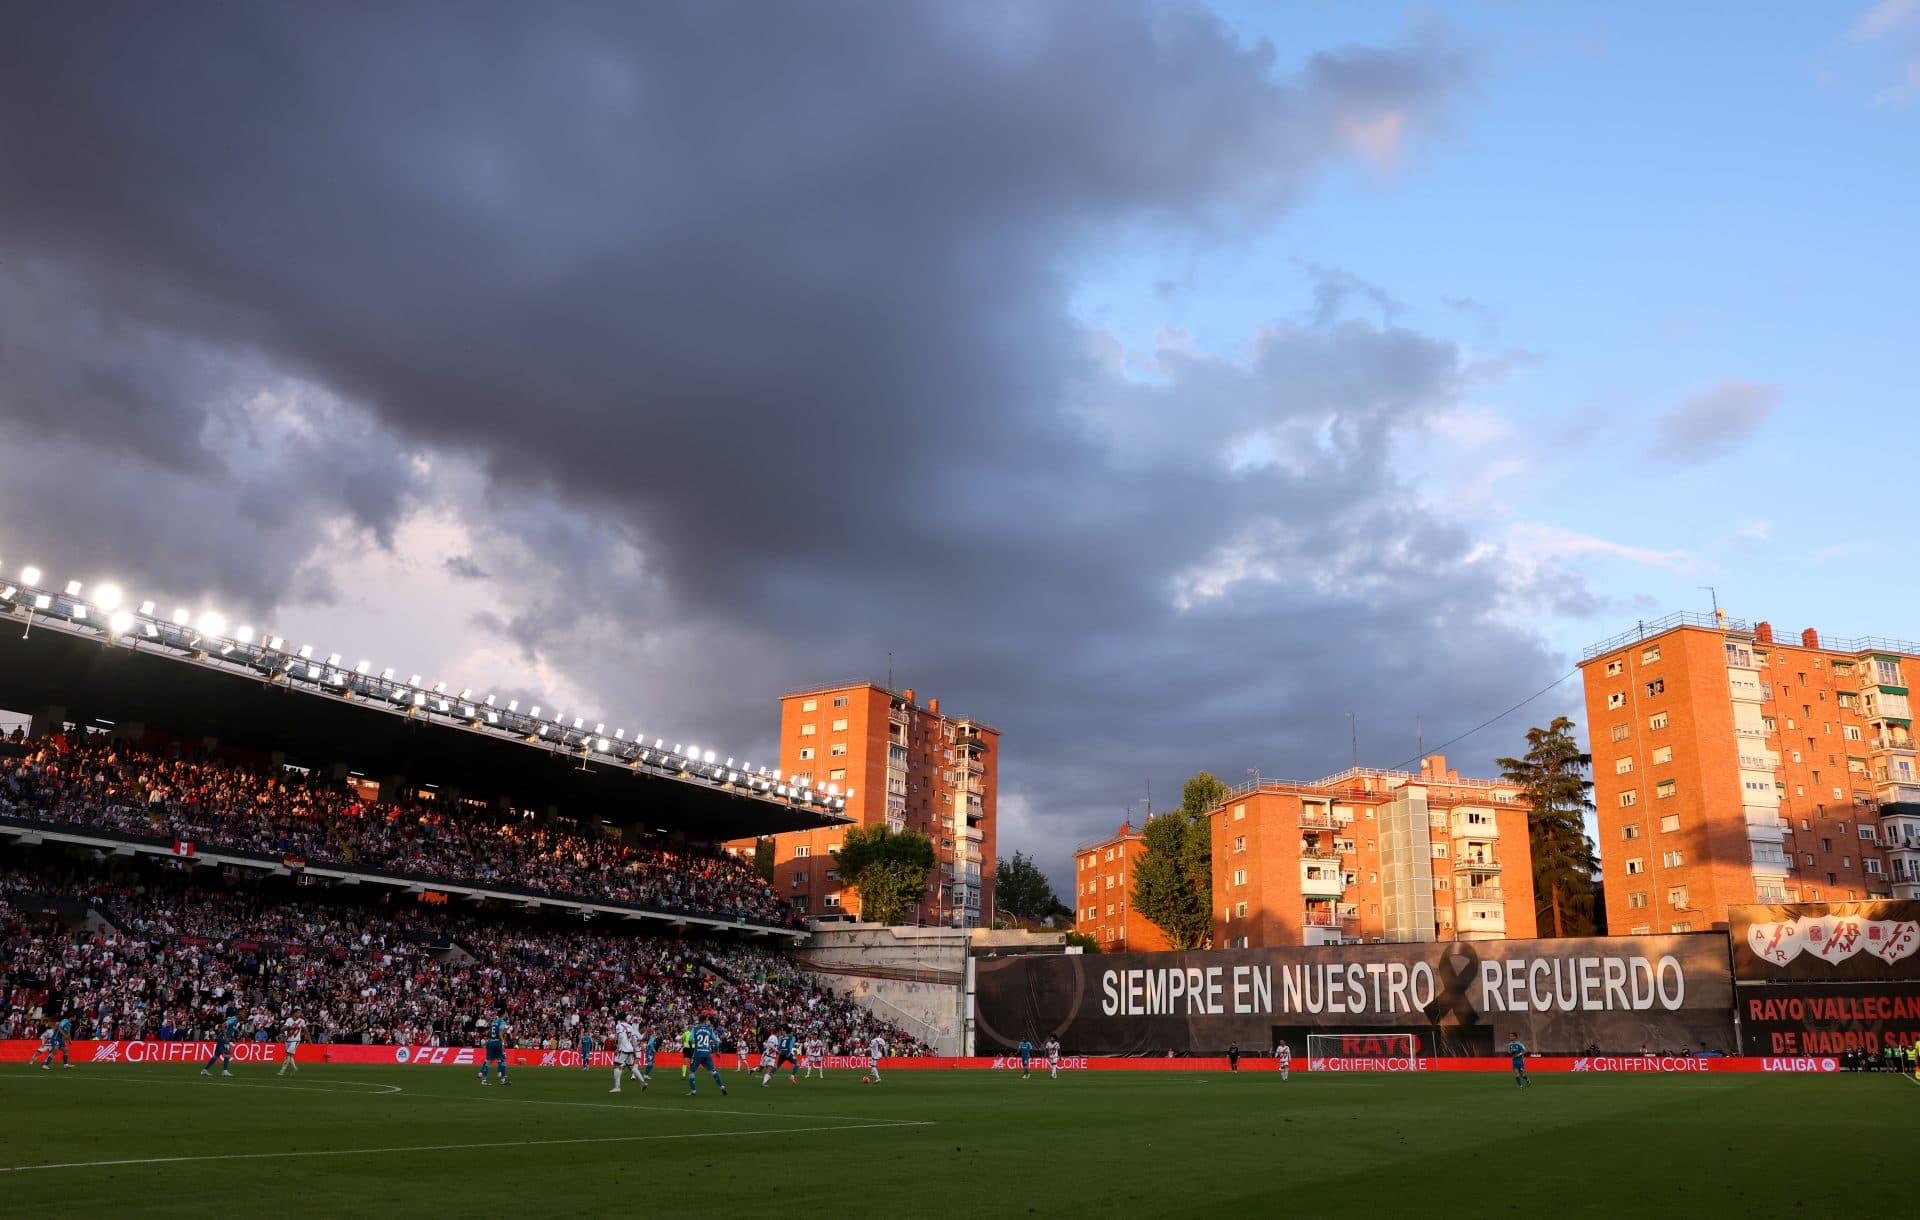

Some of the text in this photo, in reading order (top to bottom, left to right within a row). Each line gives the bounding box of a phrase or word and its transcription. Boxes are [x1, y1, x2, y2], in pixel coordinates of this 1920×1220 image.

[1755, 927, 1794, 939] A D
[1839, 943, 1852, 952] M
[1775, 950, 1787, 961] R
[1102, 955, 1685, 1016] SIEMPRE EN NUESTRO RECUERDO
[1750, 998, 1803, 1021] RAYO
[697, 1034, 709, 1048] 24
[1343, 1034, 1421, 1055] RAYO
[1771, 1032, 1797, 1054] DE
[1802, 1031, 1878, 1054] MADRID
[413, 1047, 448, 1064] FC
[1328, 1057, 1428, 1071] GRIFFINCORE
[1594, 1057, 1709, 1071] GRIFFINCORE
[1763, 1057, 1817, 1071] LALIGA
